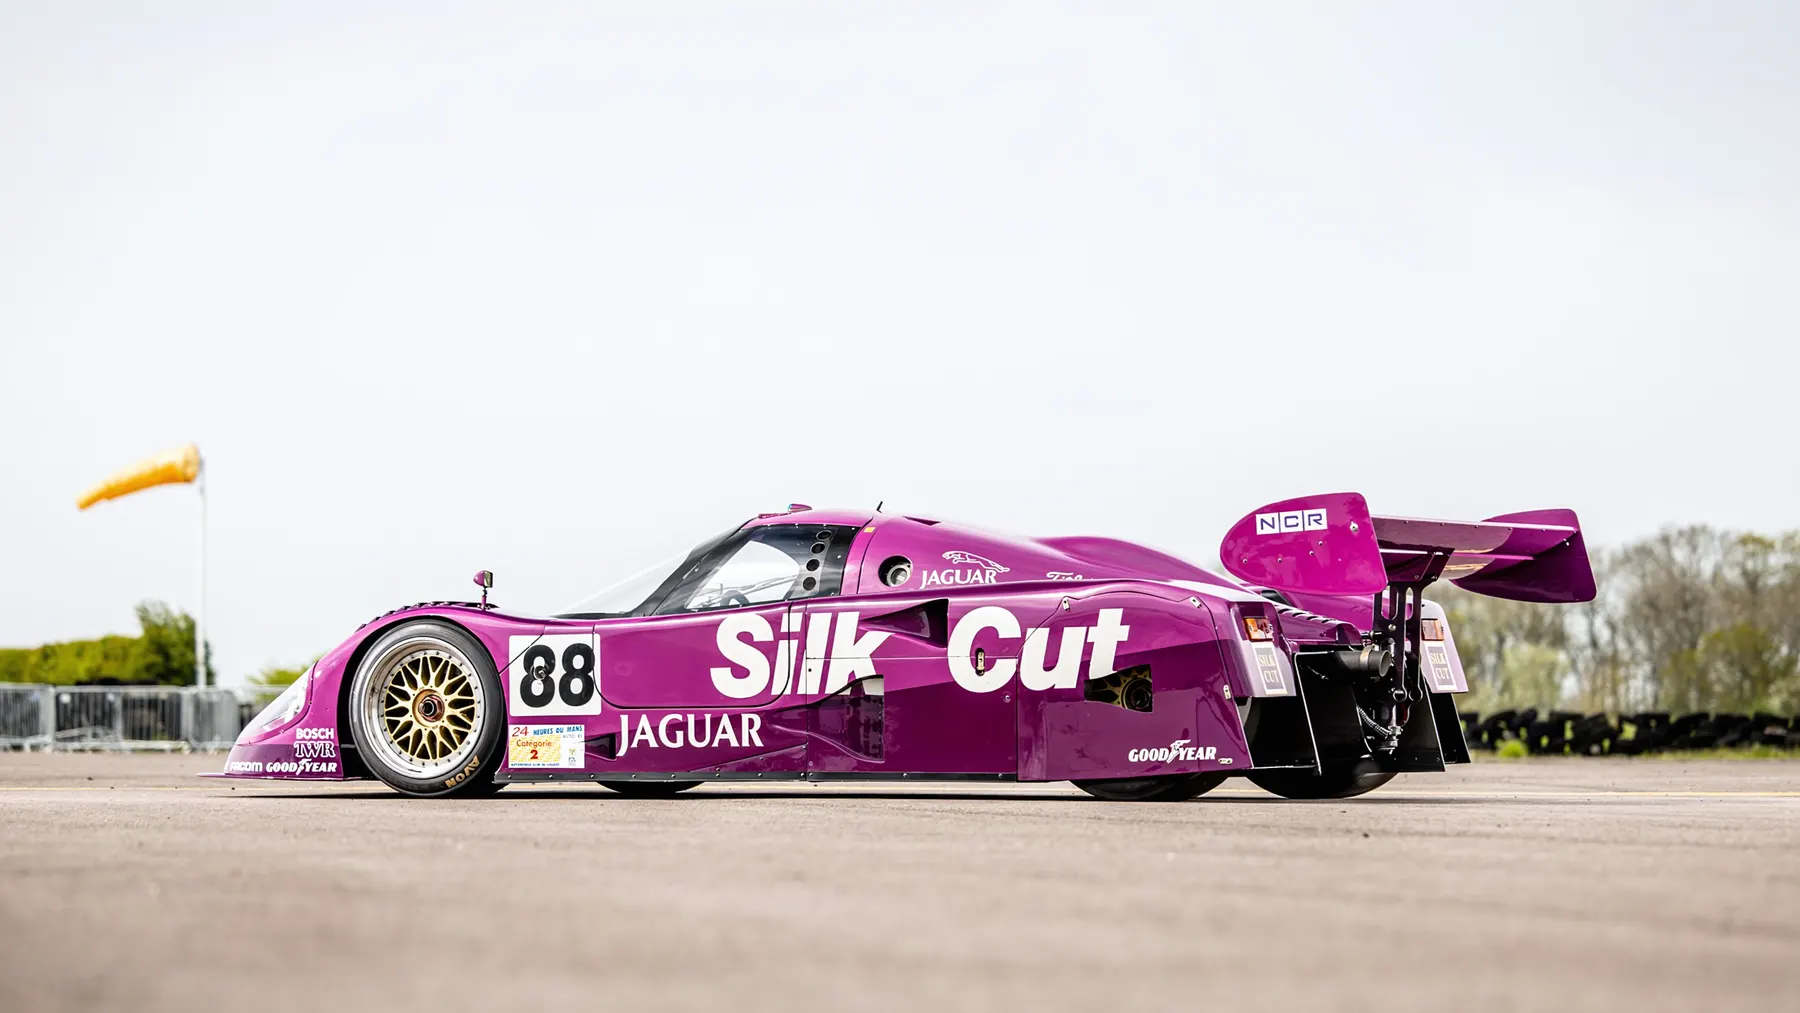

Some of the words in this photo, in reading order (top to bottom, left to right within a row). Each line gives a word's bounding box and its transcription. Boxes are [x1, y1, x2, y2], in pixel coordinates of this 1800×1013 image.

[1260, 513, 1323, 531] NCR
[919, 568, 997, 590] JAGUAR
[710, 610, 896, 699] Silk
[948, 606, 1130, 694] Cut
[1257, 654, 1277, 667] SILK
[520, 643, 595, 708] 88
[1263, 670, 1279, 683] CUT
[1435, 667, 1450, 680] CUT
[295, 728, 335, 740] BOSCH
[512, 726, 529, 737] 24
[616, 713, 765, 756] JAGUAR
[293, 740, 336, 758] TWR
[530, 749, 538, 760] 2
[444, 755, 480, 788] AVON
